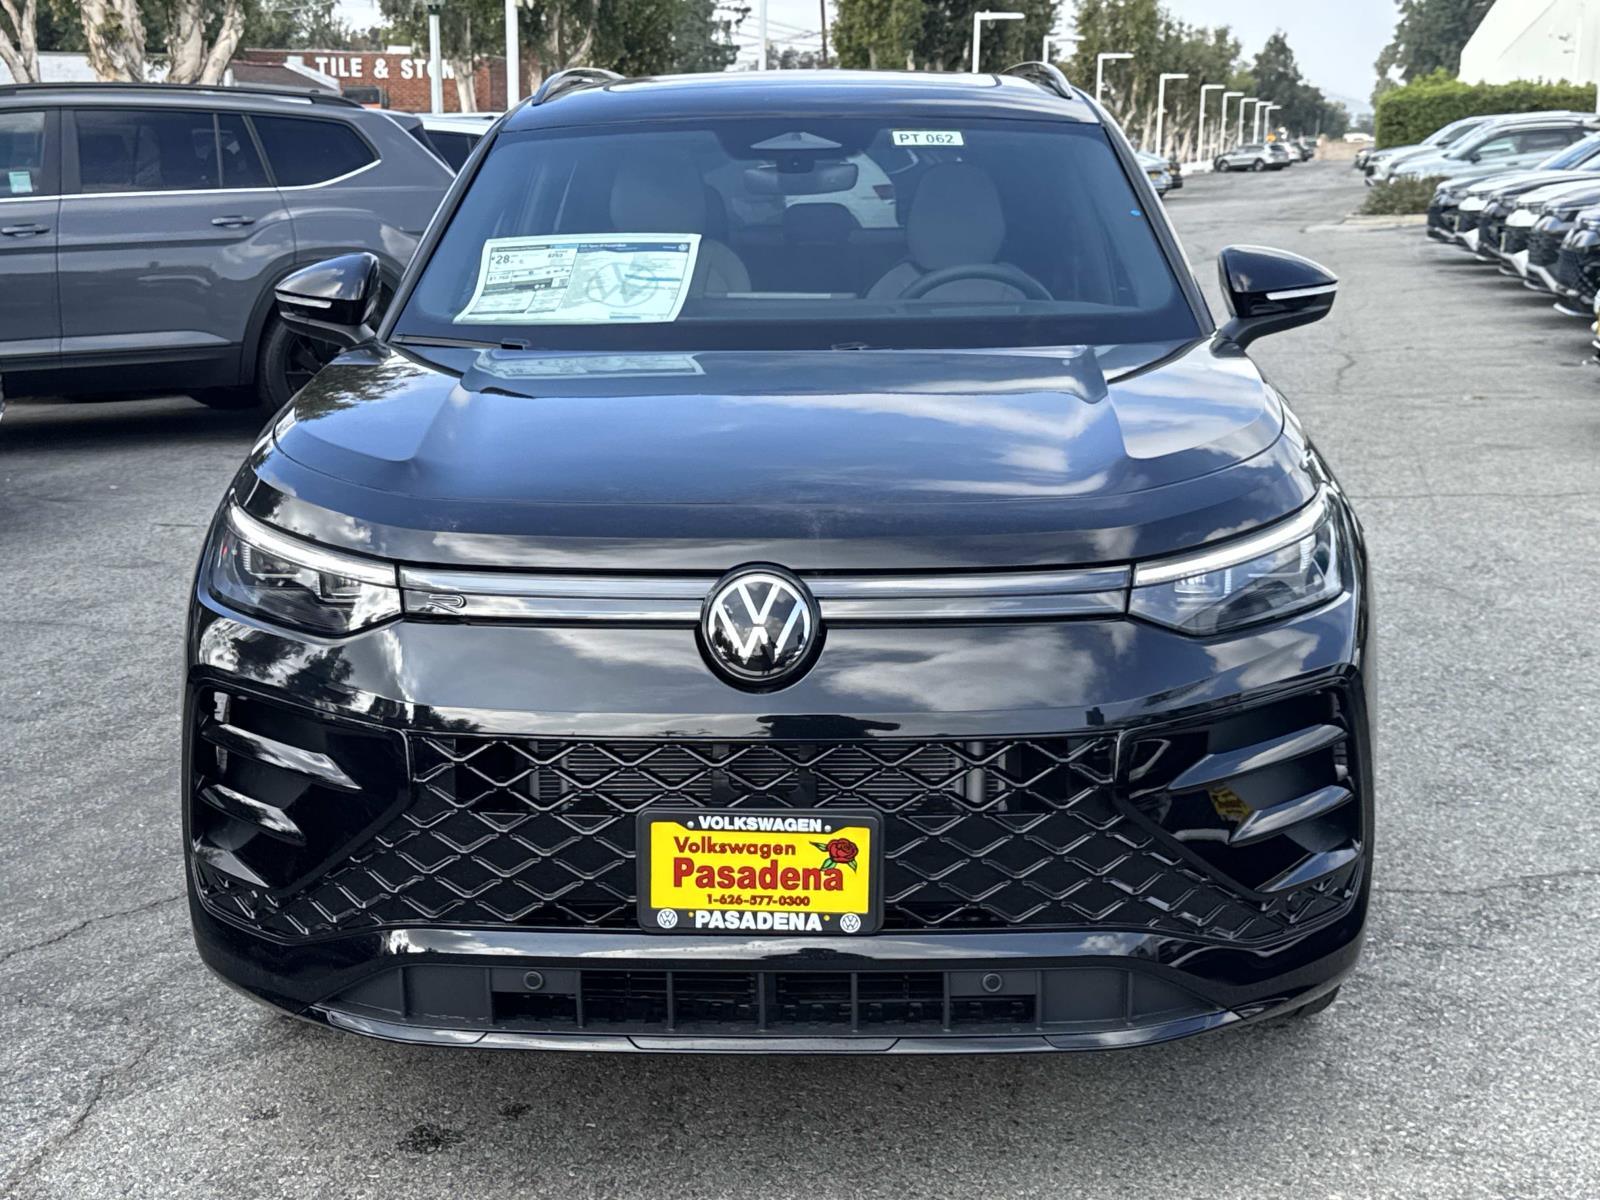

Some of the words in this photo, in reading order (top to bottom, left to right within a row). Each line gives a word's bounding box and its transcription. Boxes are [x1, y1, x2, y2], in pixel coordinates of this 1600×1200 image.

[315, 57, 363, 78] TILE
[373, 58, 389, 79] &
[899, 133, 920, 144] PT
[925, 133, 955, 144] 062
[698, 815, 822, 832] VOLKSWAGEN
[673, 836, 796, 858] Volkswagen
[673, 857, 844, 890] Pasadena
[707, 893, 811, 906] 1-626-577-0300
[695, 911, 822, 931] PASADENA
